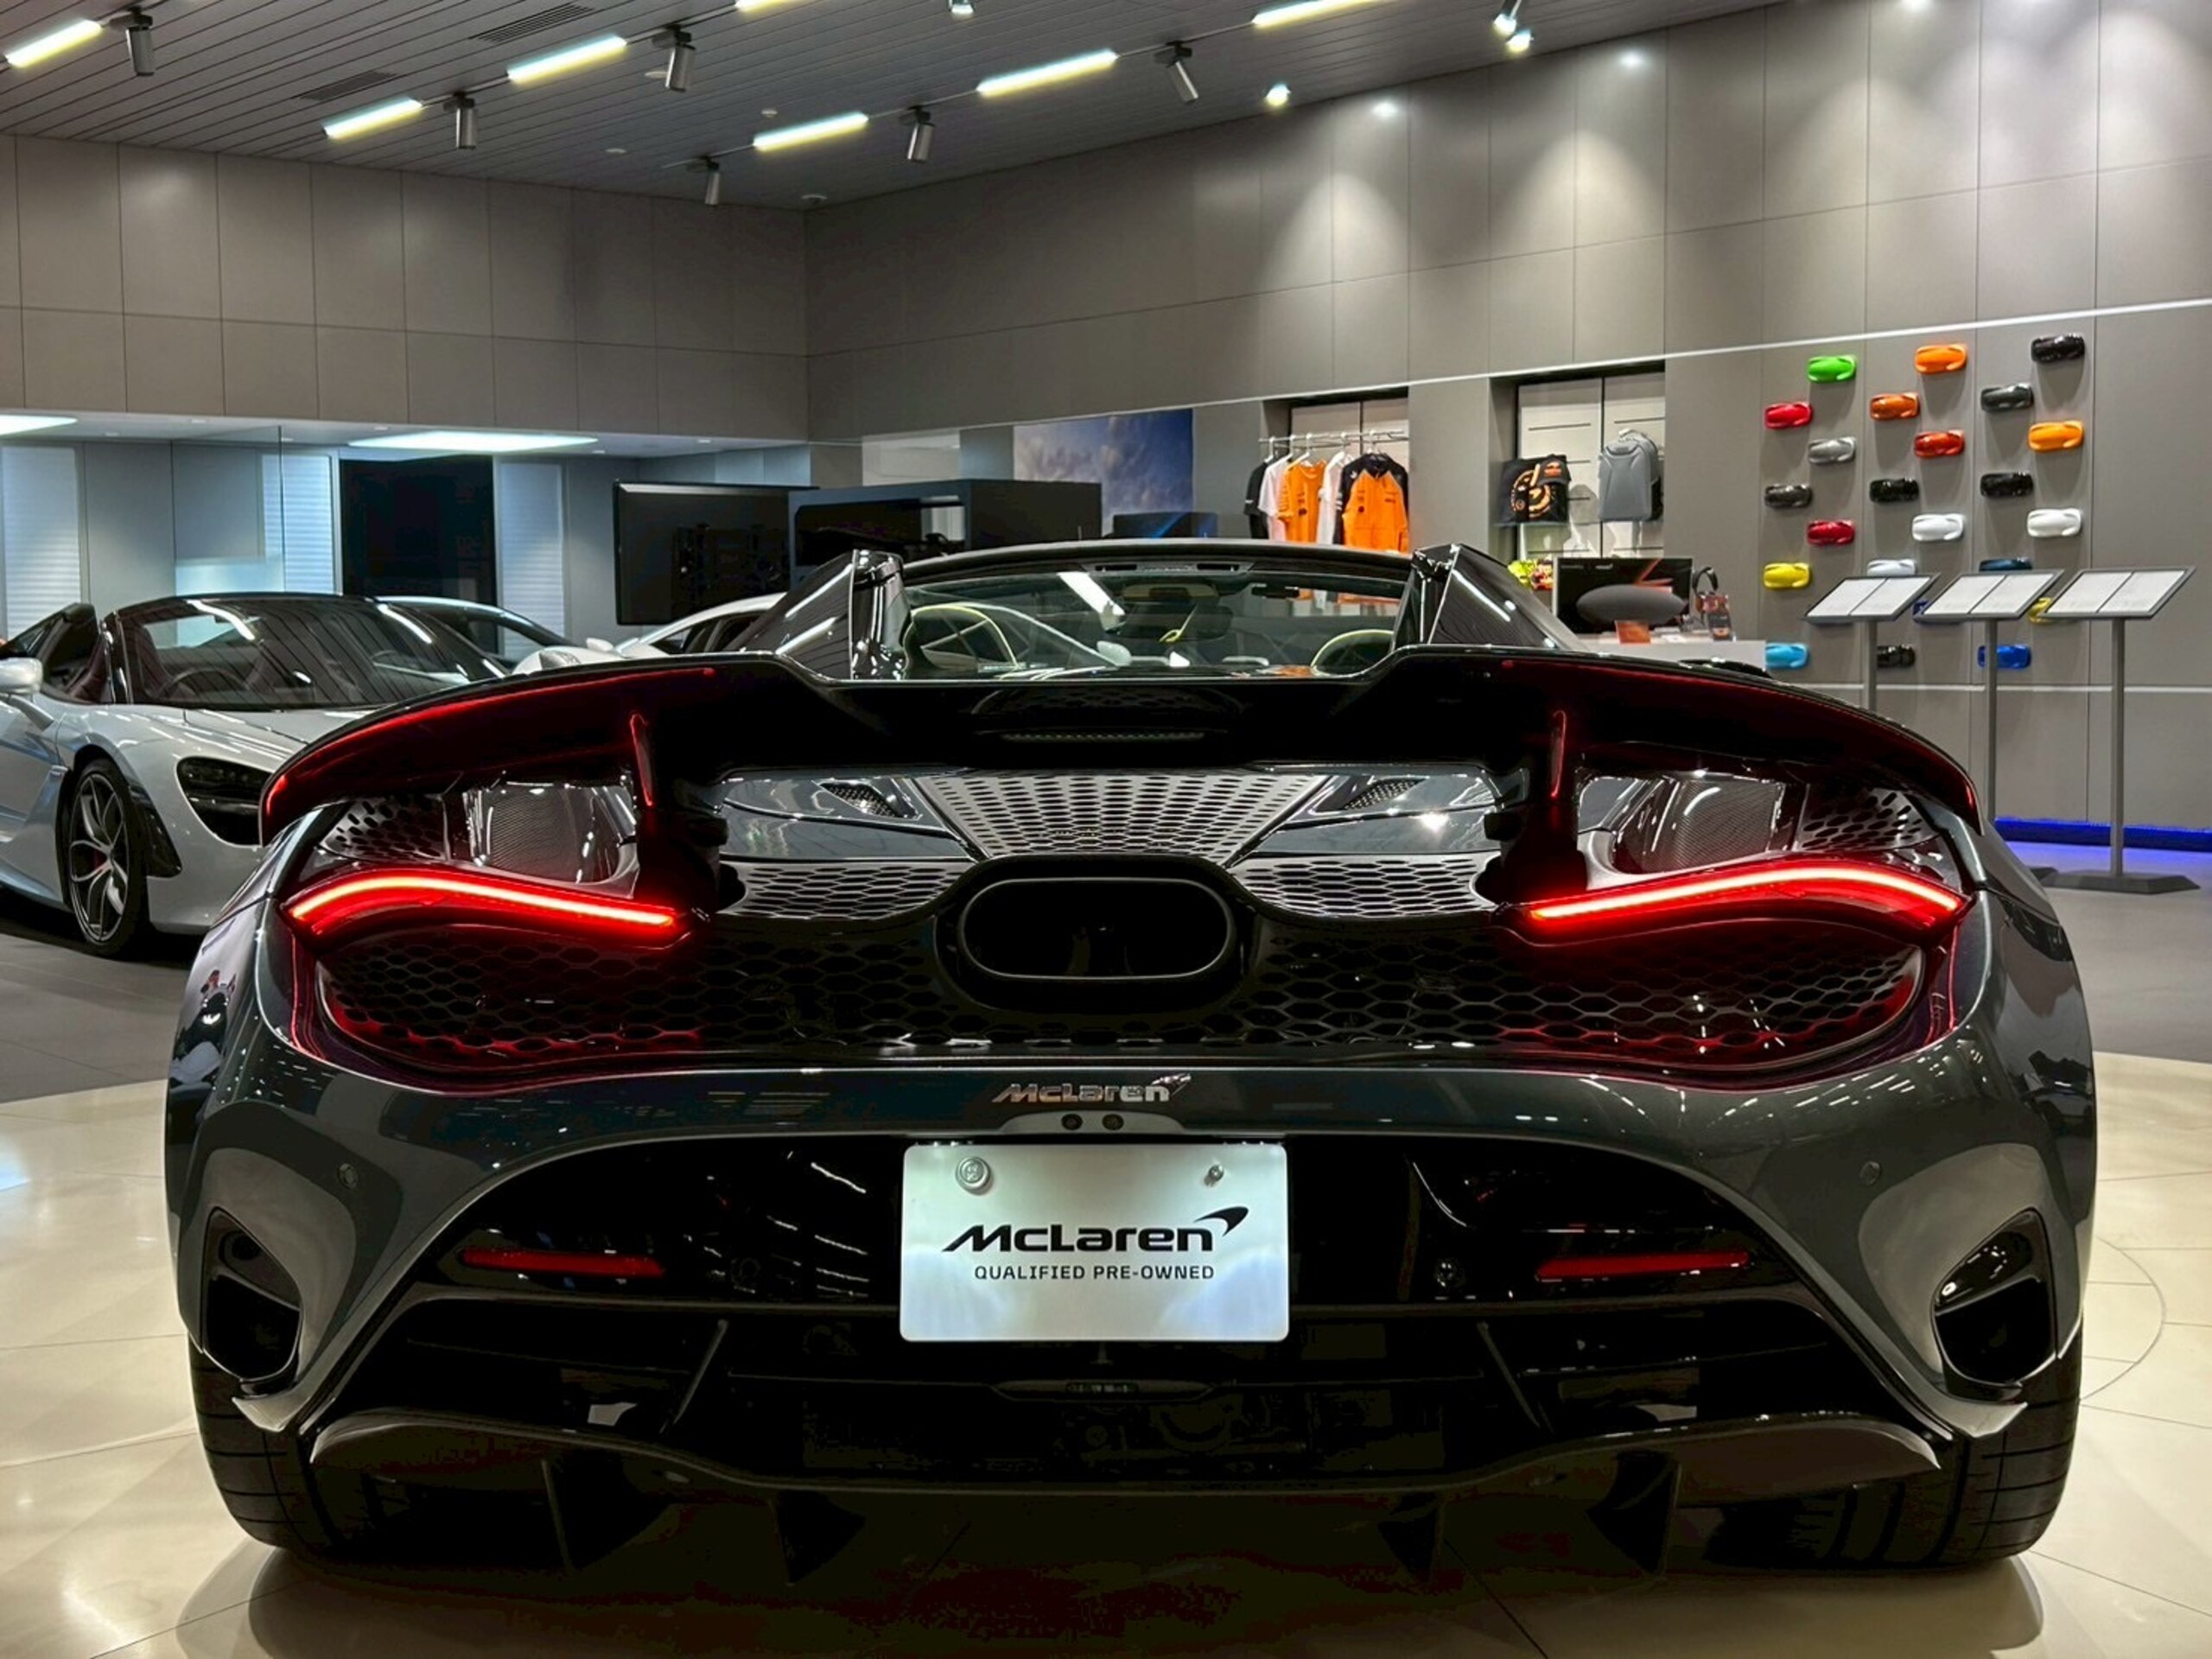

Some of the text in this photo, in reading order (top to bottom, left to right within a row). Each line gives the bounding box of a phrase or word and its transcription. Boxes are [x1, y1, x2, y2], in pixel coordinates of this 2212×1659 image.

[993, 1083, 1171, 1103] McLaren
[942, 1224, 1214, 1252] McLaren
[975, 1265, 1215, 1280] QUALIFIED PRE-OWNED
